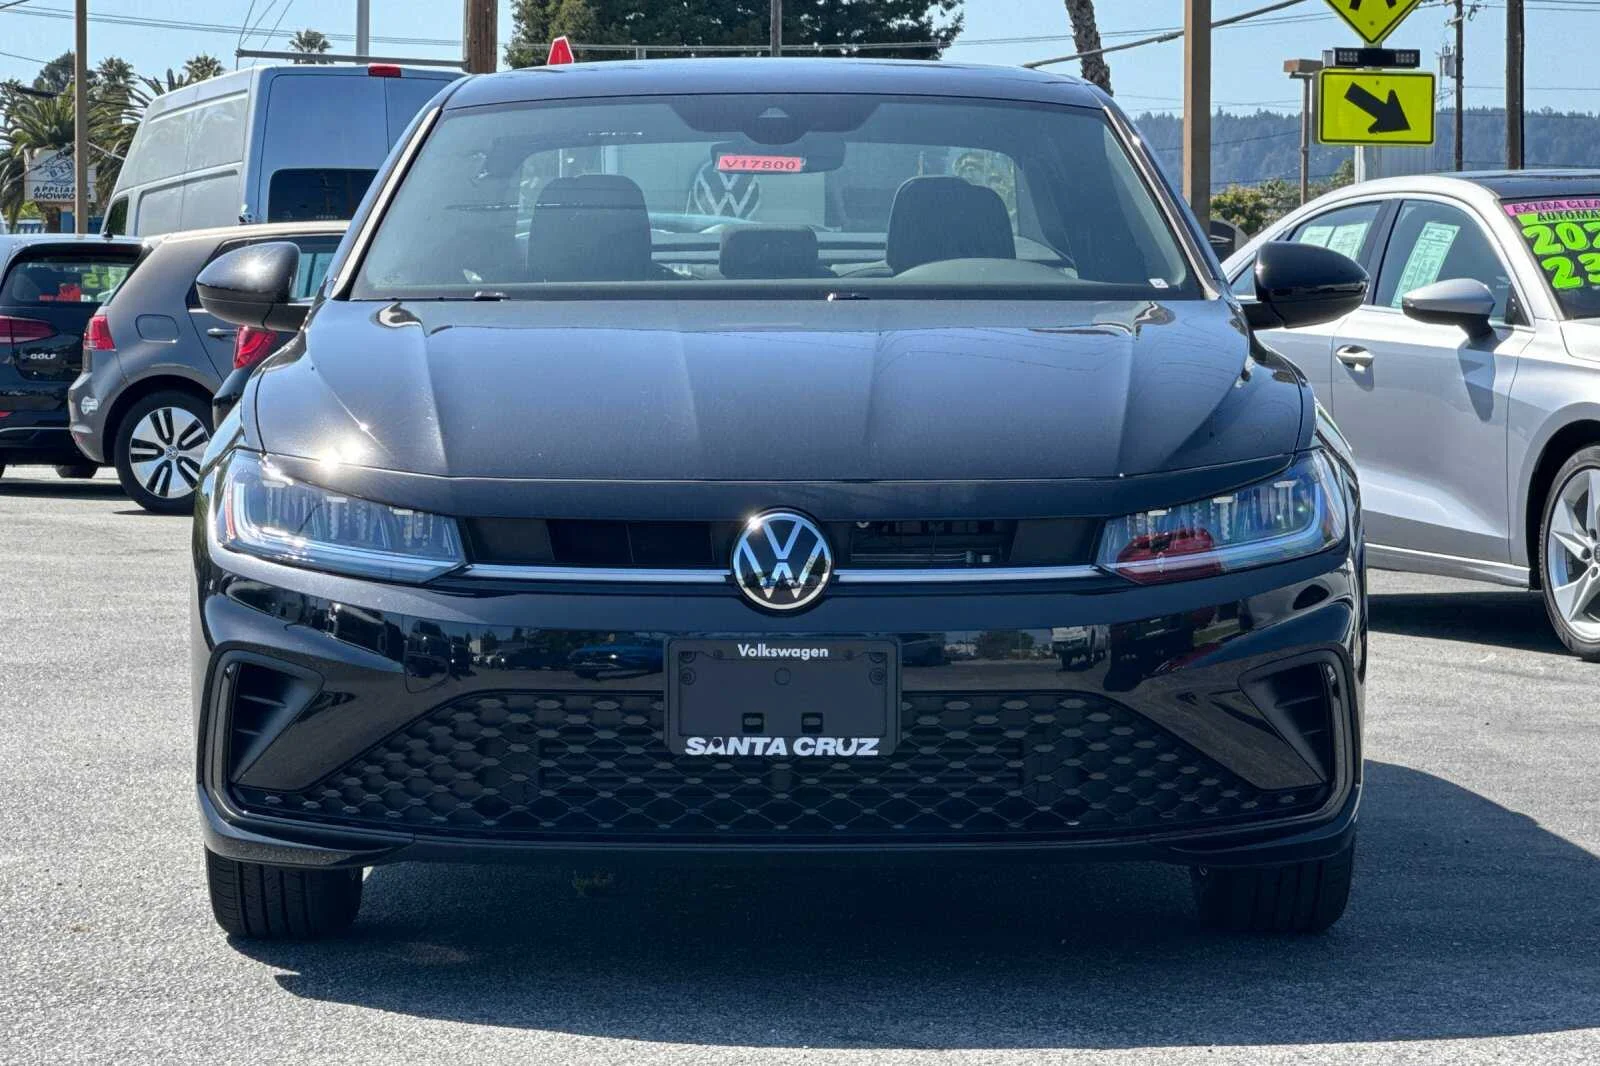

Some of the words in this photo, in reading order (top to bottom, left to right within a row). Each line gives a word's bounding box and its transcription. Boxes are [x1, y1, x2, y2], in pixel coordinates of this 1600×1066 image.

[724, 159, 797, 170] V17800
[1512, 200, 1565, 214] EXTRA
[737, 643, 829, 660] Volkswagen
[684, 736, 788, 756] SANTA
[793, 736, 879, 756] CRUZ
